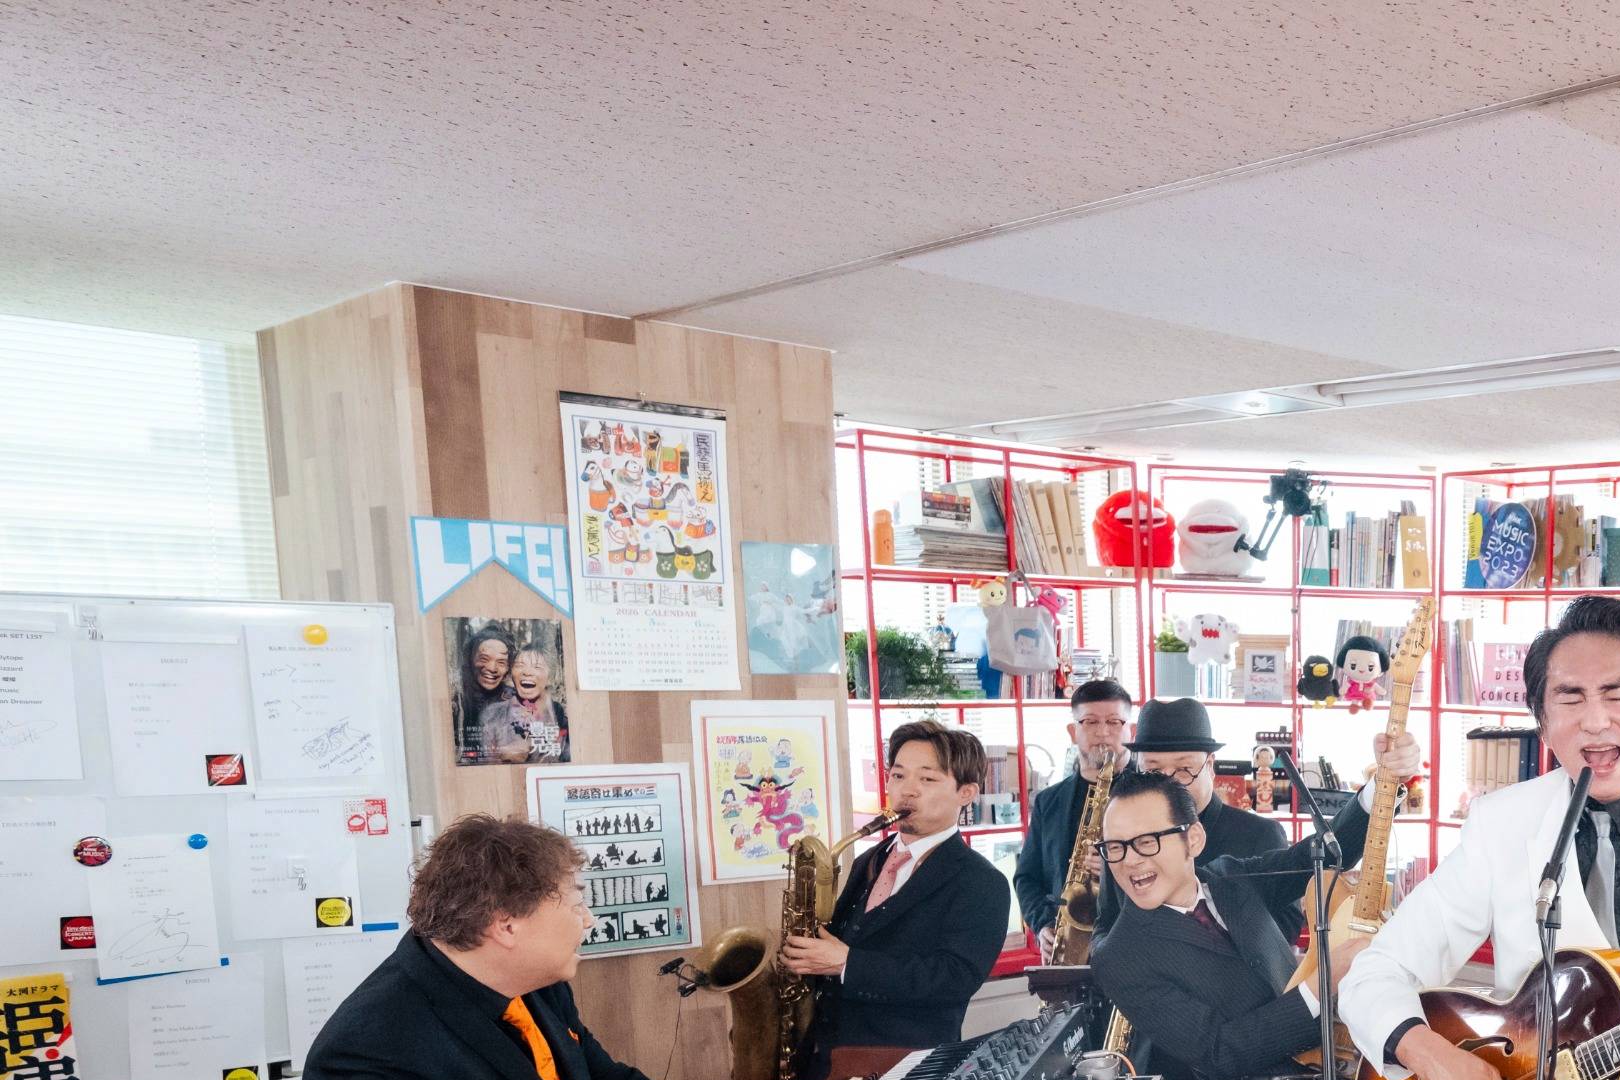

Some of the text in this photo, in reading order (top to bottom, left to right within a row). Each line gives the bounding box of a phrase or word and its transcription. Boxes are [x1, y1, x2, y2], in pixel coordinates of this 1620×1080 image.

[1492, 519, 1529, 546] MUSIC
[1486, 536, 1524, 562] EXPO
[415, 519, 570, 612] LIFE!
[1483, 551, 1519, 578] 2023
[644, 608, 697, 618] CALENDAR
[1495, 670, 1520, 681] DES
[1481, 690, 1528, 703] CONCER
[7, 984, 60, 997] 大河ドラマ
[0, 996, 73, 1060] 臣!
